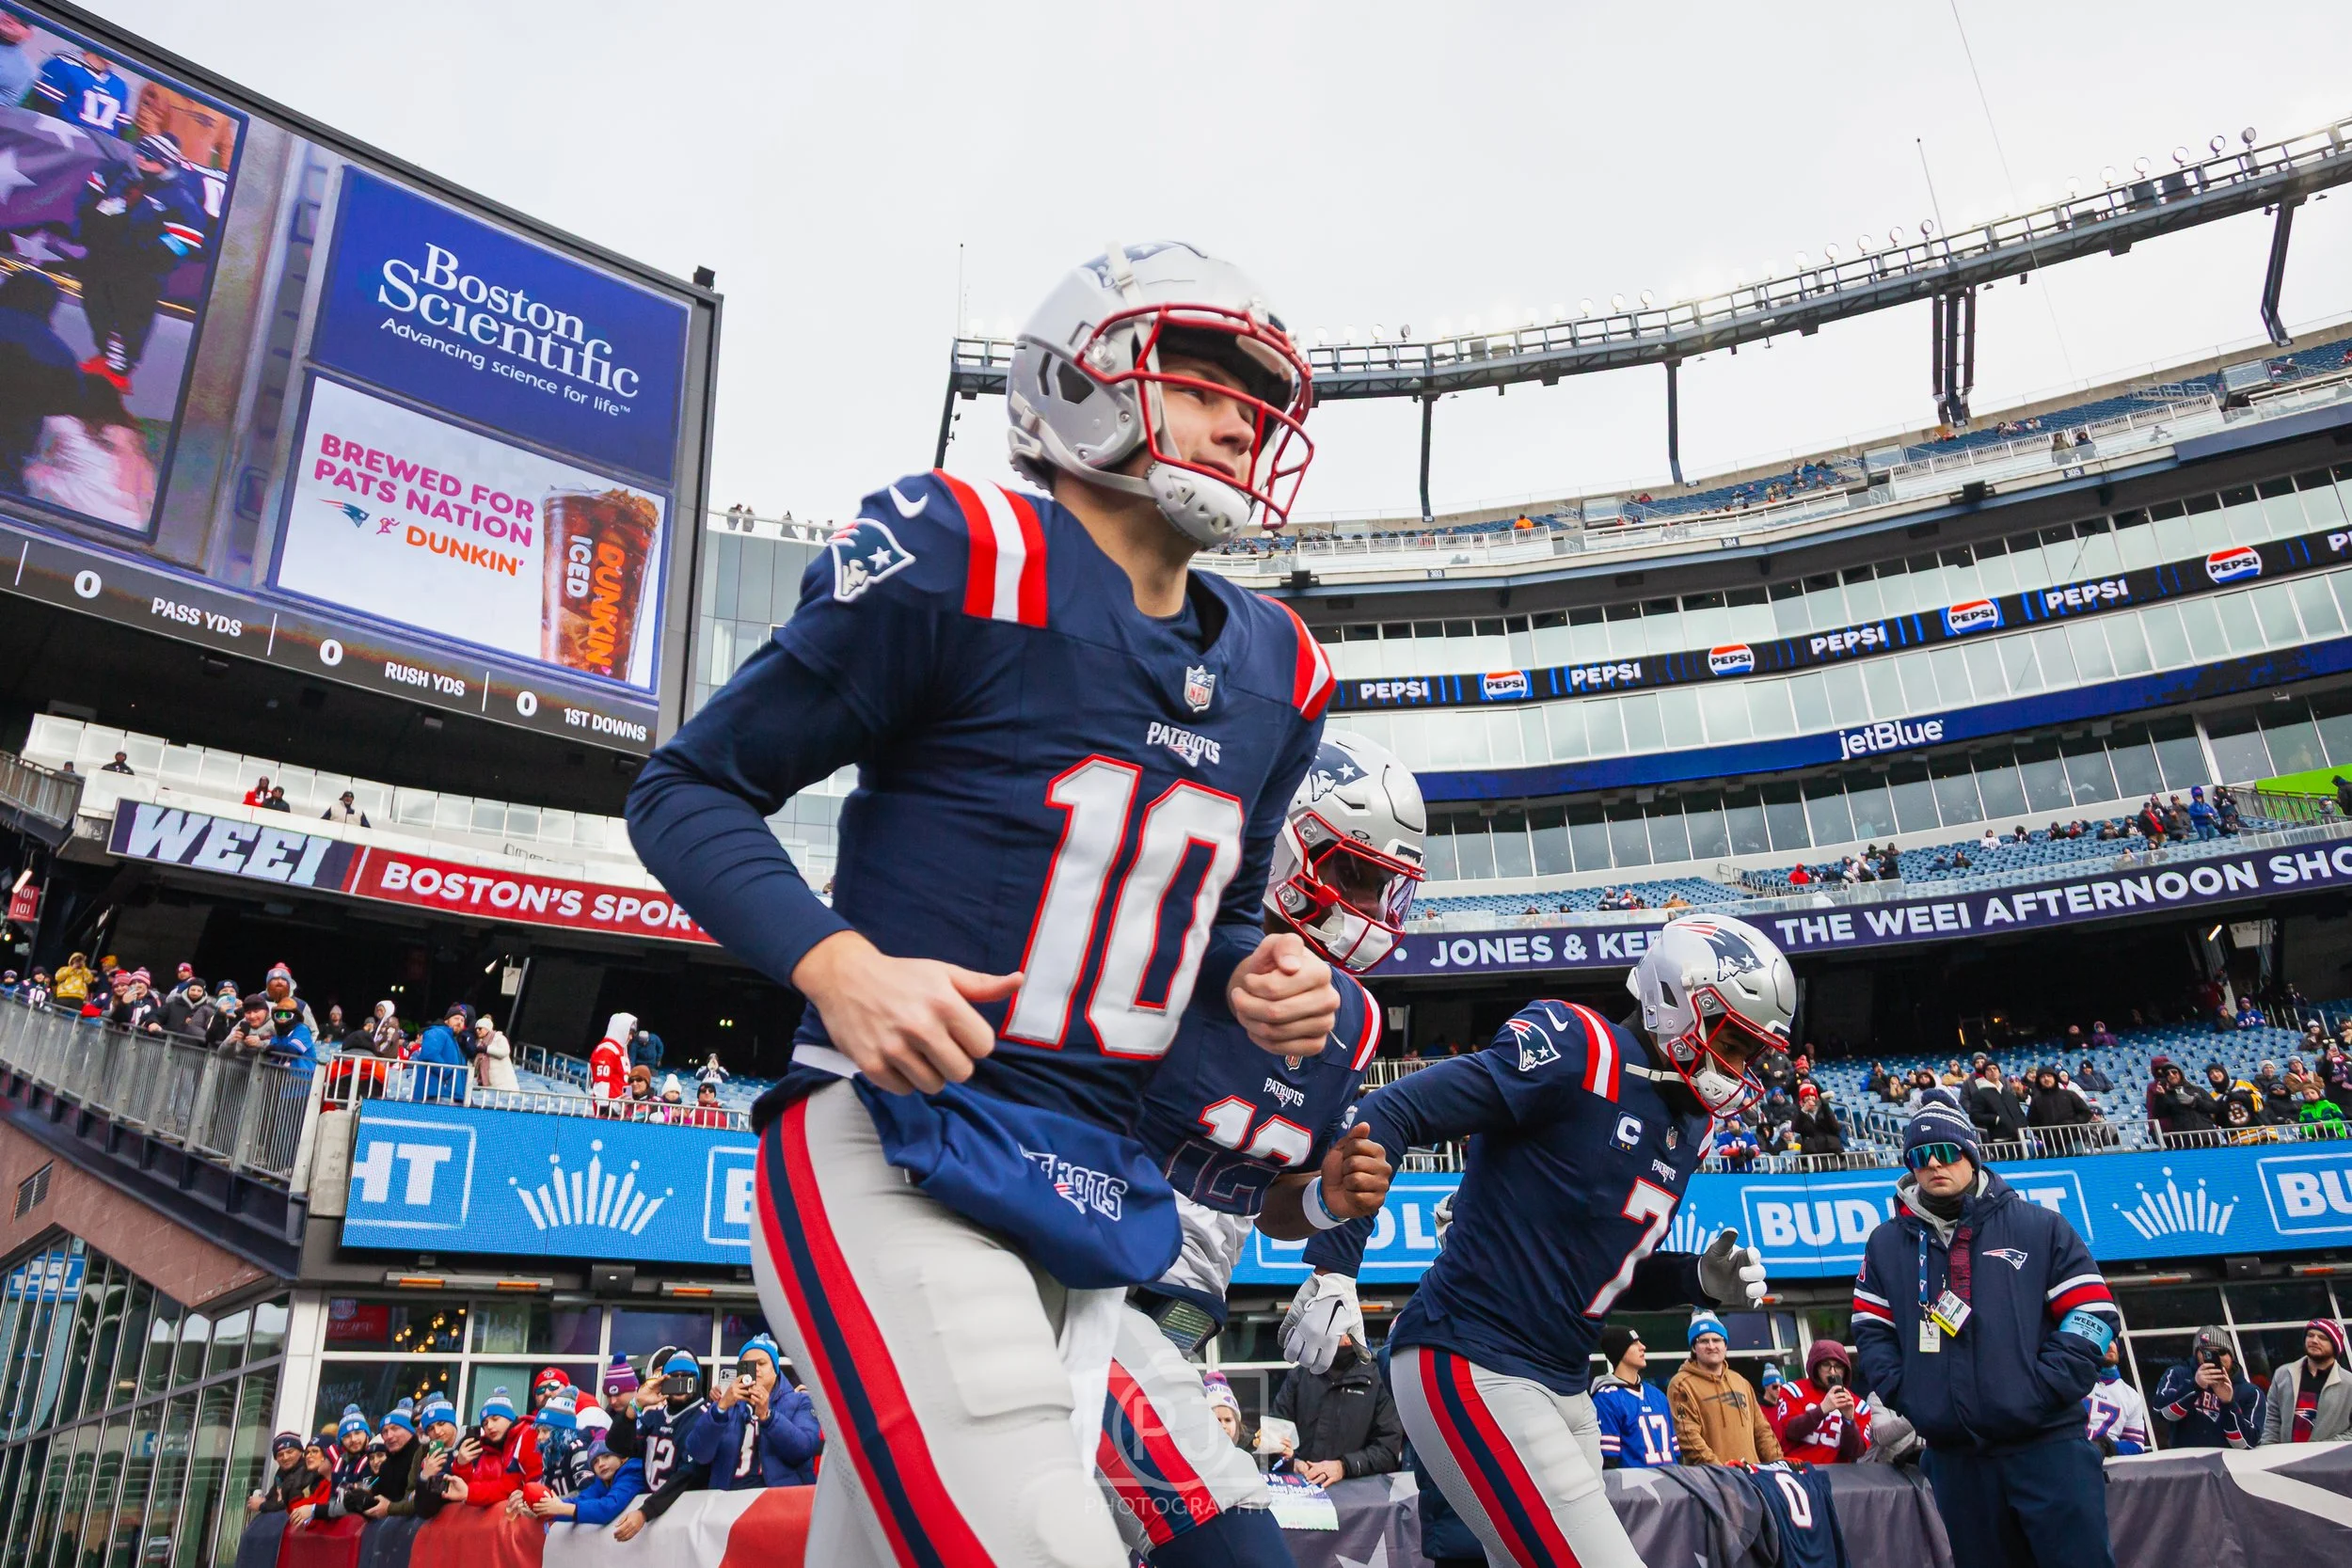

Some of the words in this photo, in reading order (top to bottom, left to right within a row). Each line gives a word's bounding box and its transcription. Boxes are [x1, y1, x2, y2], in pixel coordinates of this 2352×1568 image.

[420, 242, 584, 344] Boston
[378, 259, 640, 398] Scientific
[380, 317, 485, 371] Advancing
[491, 360, 558, 394] science
[564, 385, 588, 404] for
[320, 433, 462, 497] BREWED
[470, 484, 534, 522] FOR
[2065, 467, 2081, 478] 305
[314, 458, 397, 503] PATS
[406, 489, 532, 547] NATION
[405, 525, 524, 577] DUNKIN'
[566, 534, 593, 598] ICED
[1723, 538, 1739, 547] 304
[1430, 569, 1443, 578] 303
[1360, 681, 1428, 700] PEPSI
[1486, 678, 1525, 692] PEPSI
[1570, 662, 1642, 687] PEPSI
[1710, 653, 1753, 667] PEPSI
[1810, 626, 1886, 655] PEPSI
[1950, 608, 1995, 626] PEPSI
[2046, 578, 2129, 610] PEPSI
[2209, 555, 2258, 576] PEPSI
[74, 570, 102, 598] 0
[151, 596, 199, 626] PASS
[204, 611, 243, 637] YDS
[320, 639, 343, 666] 0
[385, 661, 428, 688] RUSH
[432, 673, 466, 697] YDS
[516, 690, 537, 717] 0
[564, 706, 590, 728] 1ST
[592, 717, 647, 741] DOWNS
[1146, 721, 1222, 766] PATRIOTS
[1839, 719, 1944, 760] jetBlue
[127, 801, 333, 887] WEEI
[15, 903, 31, 914] 101
[379, 860, 585, 918] BOSTON'S
[590, 893, 706, 932] SPOR
[999, 753, 1245, 1061] 10
[1430, 934, 1554, 968] JONES
[1563, 933, 1588, 961] &
[1775, 912, 1856, 946] THE
[1865, 901, 1972, 938] WEEI
[1982, 861, 2260, 927] AFTERNOON
[596, 1064, 610, 1077] 50
[1263, 1077, 1305, 1107] PATRIOTS
[1617, 1116, 1643, 1147] C
[2277, 1169, 2352, 1215] BU
[1583, 1175, 1679, 1316] 7
[1756, 1198, 1882, 1248] BUD
[2074, 1315, 2096, 1327] WEEK
[644, 1435, 675, 1492] 12
[1637, 1414, 1674, 1464] 17
